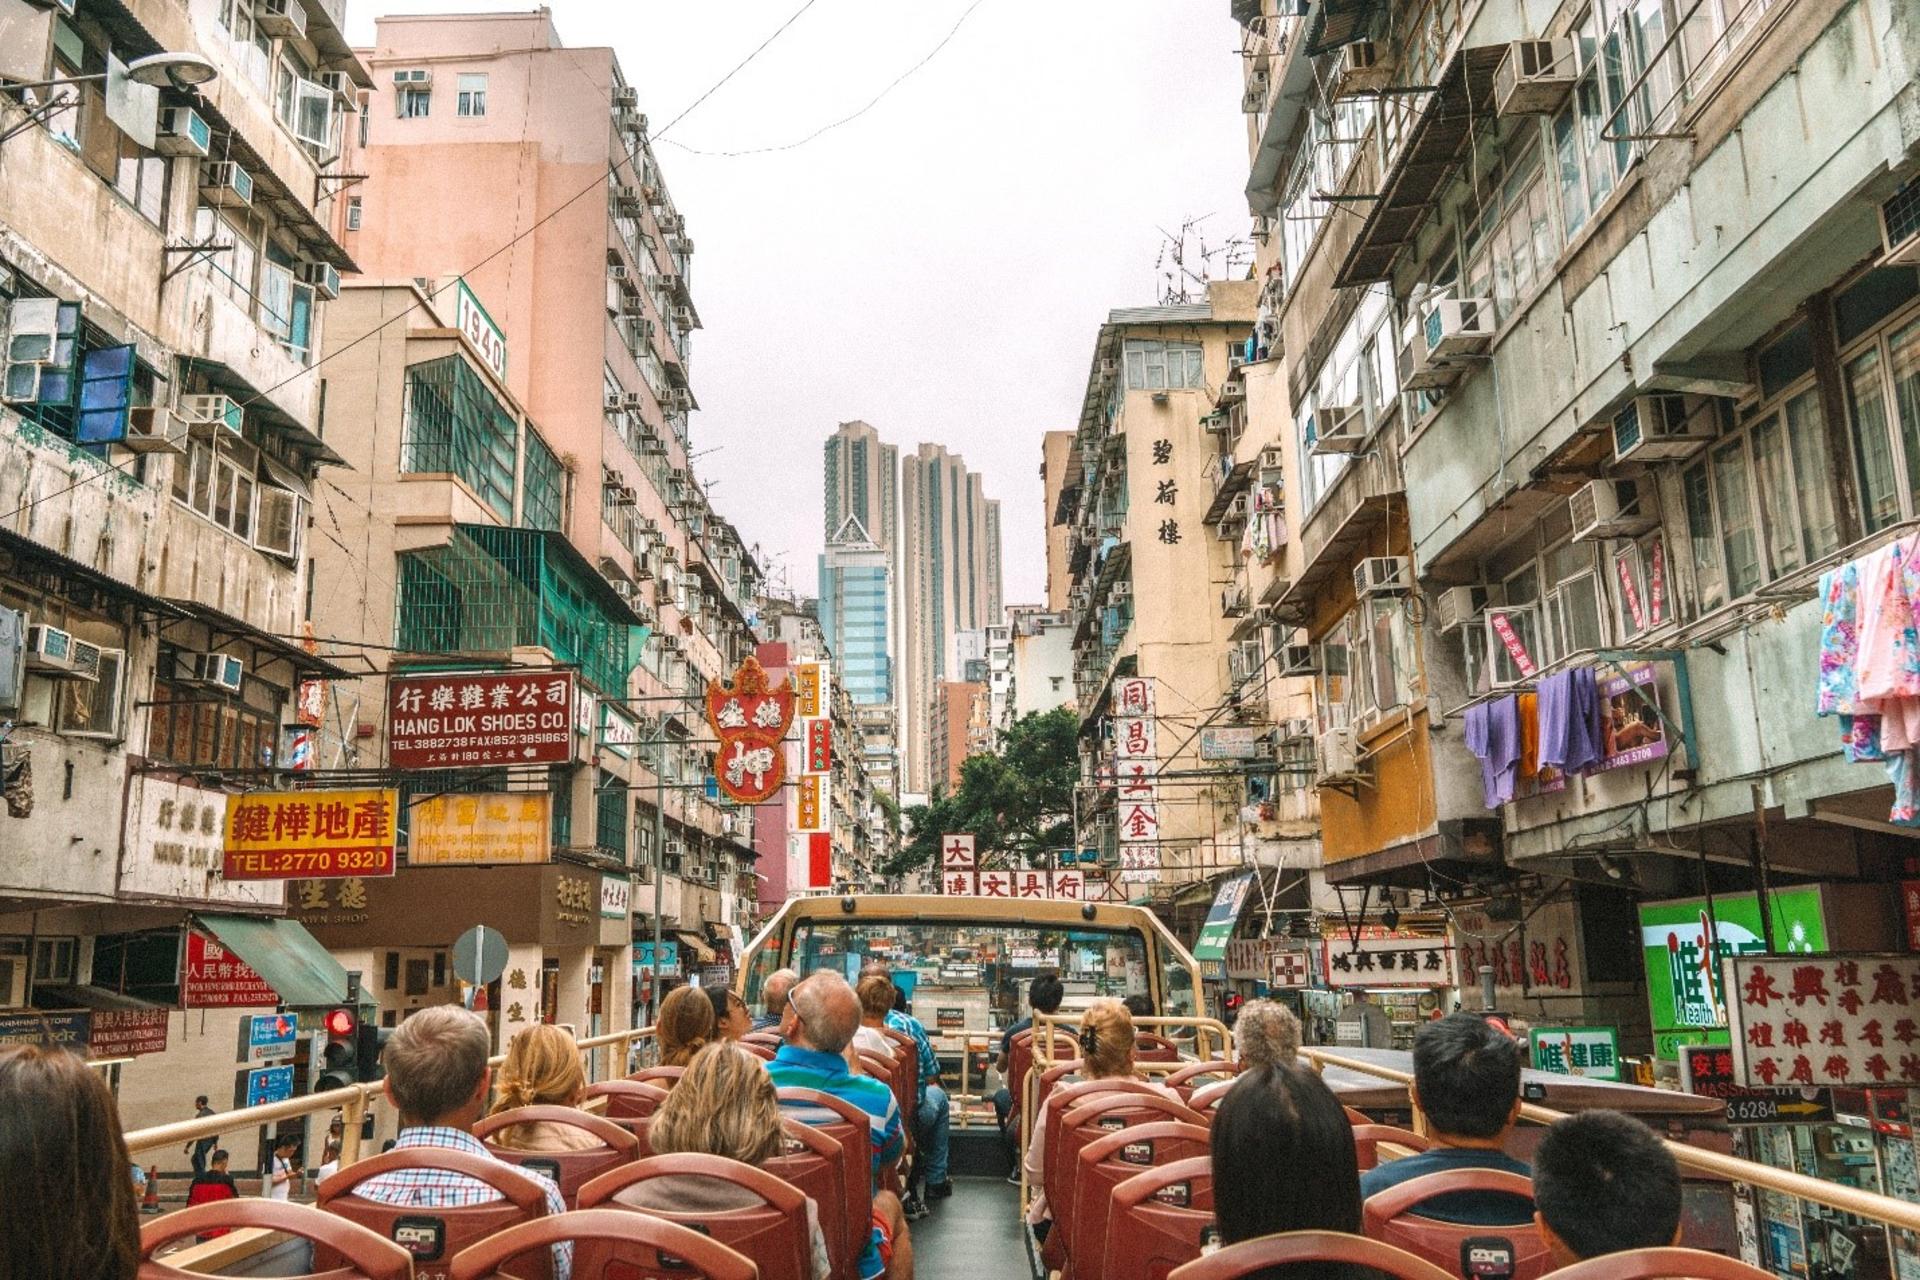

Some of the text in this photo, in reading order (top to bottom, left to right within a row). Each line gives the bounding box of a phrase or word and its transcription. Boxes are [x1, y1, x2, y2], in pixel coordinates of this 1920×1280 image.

[464, 300, 501, 372] 1940
[396, 680, 567, 713] 行樂鞋業公司
[394, 718, 439, 735] HANG
[444, 716, 476, 733] LOK
[481, 713, 537, 731] SHOES
[541, 711, 568, 729] CO.
[415, 738, 468, 748] 3882738
[725, 741, 774, 790] 押
[1123, 681, 1157, 837] 同昌五金
[232, 800, 389, 841] 鍵樺地產
[232, 850, 387, 872] TEL:2770 9320
[946, 839, 971, 862] 大
[947, 874, 1080, 899] 達文具行
[1740, 1101, 1777, 1118] 6284
